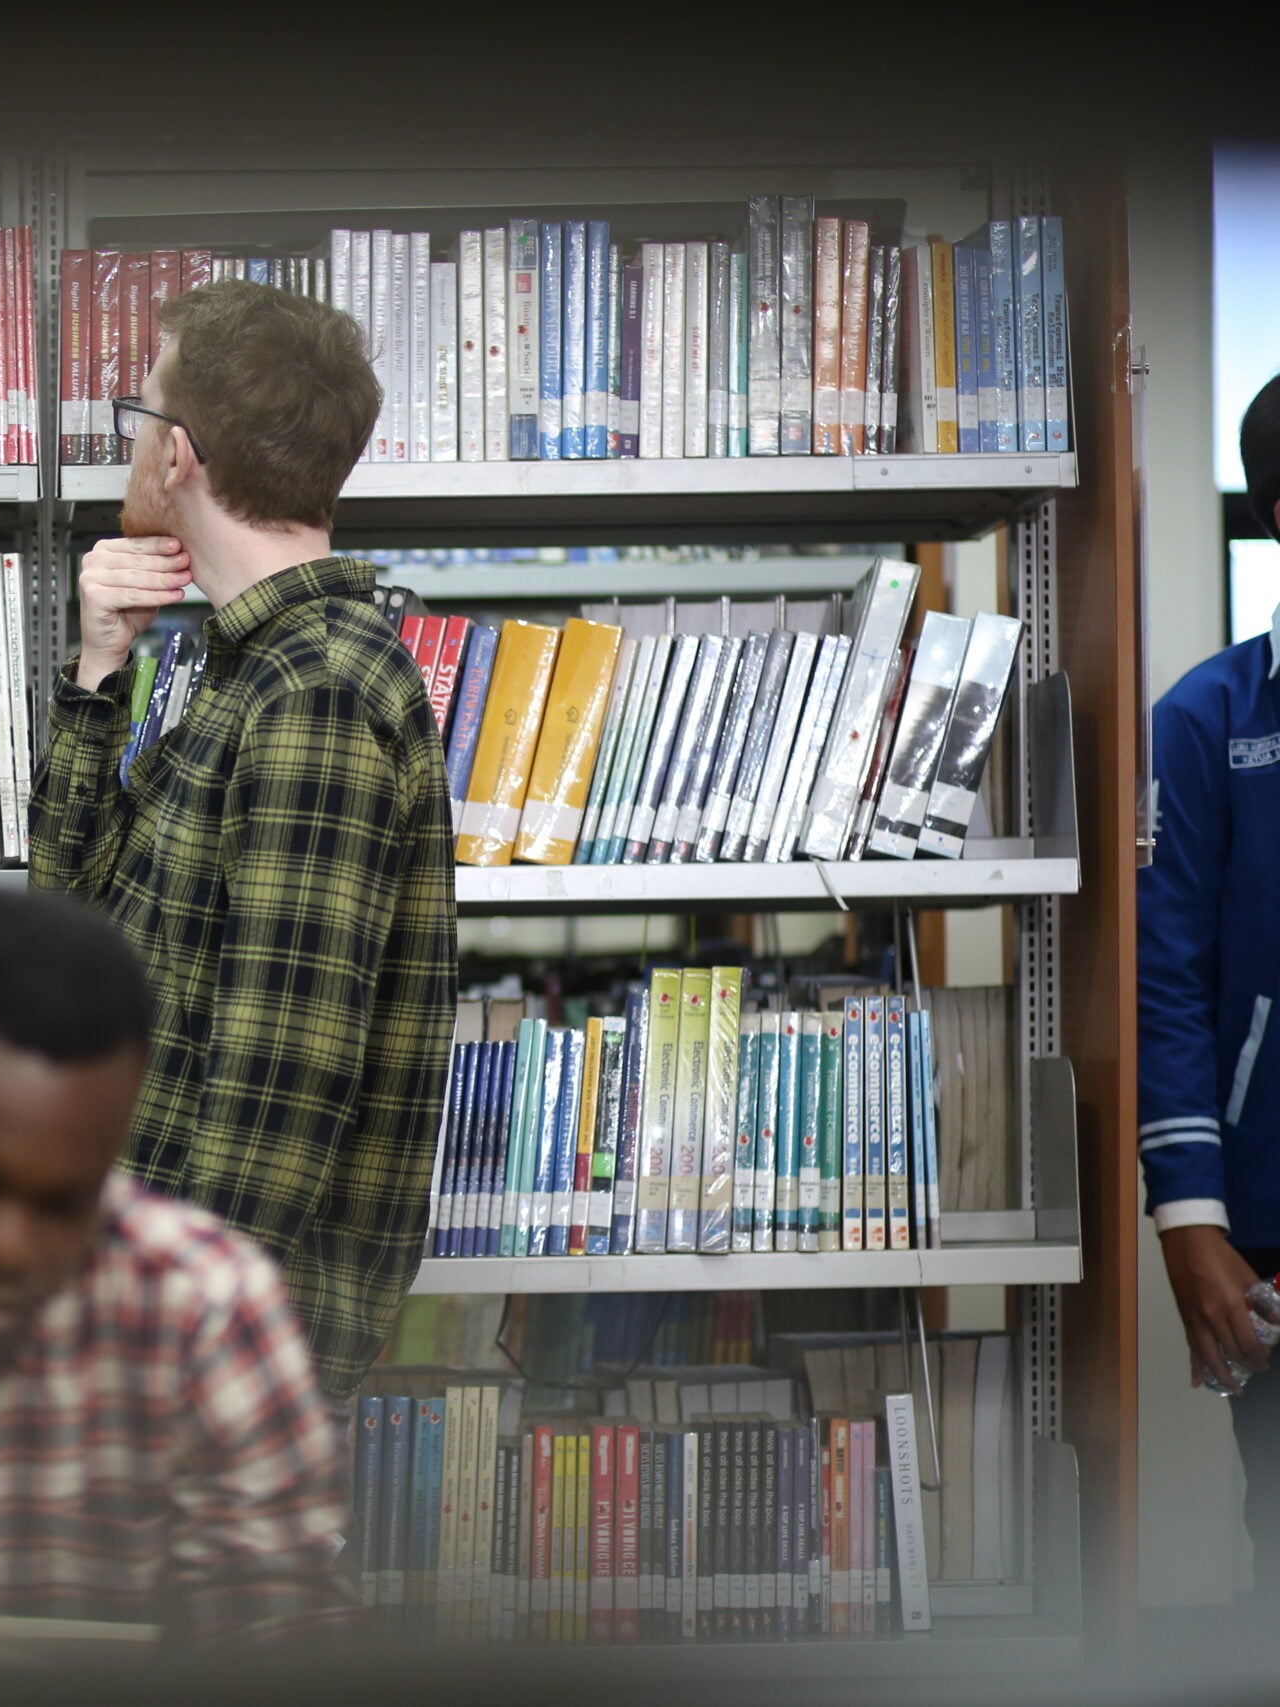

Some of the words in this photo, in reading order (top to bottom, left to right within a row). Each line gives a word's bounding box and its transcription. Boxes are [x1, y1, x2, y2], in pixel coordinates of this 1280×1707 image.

[72, 282, 80, 310] Digital
[102, 282, 110, 312] Digital
[130, 285, 138, 312] Digital
[72, 312, 80, 359] BUSINESS
[102, 314, 110, 360] BUSINESS
[130, 315, 138, 362] BUSINESS
[1054, 294, 1064, 363] Transformasi
[546, 318, 558, 372] SENDIRI
[456, 668, 484, 749] PARIWISATA
[660, 1043, 674, 1090] Electronic
[690, 1041, 704, 1088] Electronic
[848, 1034, 860, 1144] e-commerce
[869, 1034, 882, 1144] e-commerce
[890, 1034, 902, 1144] e-commerce
[688, 1092, 702, 1142] Commerce
[702, 1432, 712, 1454] think
[719, 1432, 728, 1452] think
[734, 1432, 743, 1452] think
[749, 1432, 758, 1452] think
[766, 1430, 774, 1452] think
[894, 1406, 914, 1505] LOONSHOTS
[702, 1470, 712, 1492] sides
[719, 1468, 728, 1490] sides
[734, 1468, 743, 1490] sides
[749, 1468, 758, 1490] sides
[766, 1467, 774, 1489] sides
[702, 1494, 712, 1508] the
[719, 1492, 728, 1506] the
[734, 1492, 743, 1506] the
[749, 1492, 758, 1506] the
[766, 1491, 774, 1506] the
[702, 1510, 712, 1528] box
[719, 1508, 728, 1526] box
[734, 1508, 743, 1526] box
[749, 1508, 758, 1526] box
[598, 1522, 610, 1559] YOUNG
[622, 1523, 636, 1559] YOUNG
[537, 1539, 545, 1578] NYAMAN
